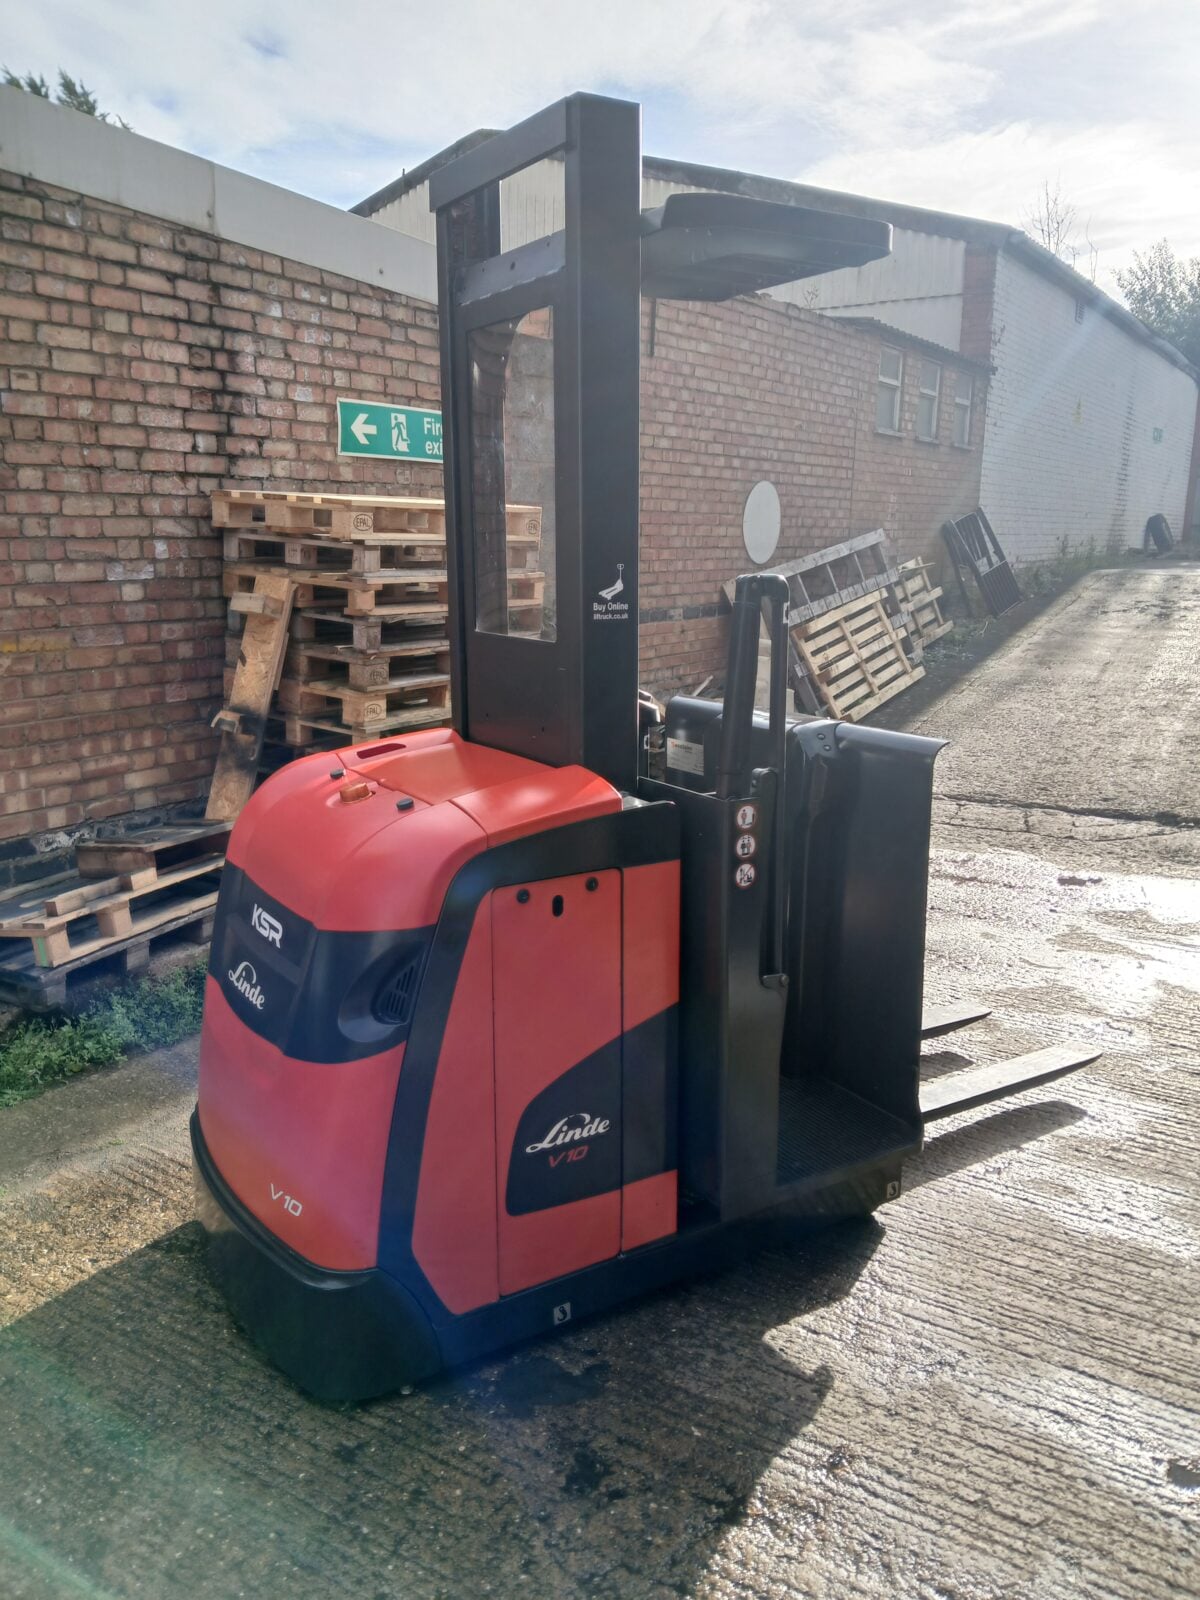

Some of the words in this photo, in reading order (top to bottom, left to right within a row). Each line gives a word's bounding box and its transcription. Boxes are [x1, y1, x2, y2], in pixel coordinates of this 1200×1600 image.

[423, 417, 442, 436] Fir
[425, 439, 443, 456] exi
[355, 515, 372, 528] EPAL
[593, 602, 606, 612] Buy
[607, 602, 629, 610] Online
[251, 903, 283, 949] KSR
[228, 961, 265, 1010] Linde
[525, 1112, 610, 1153] Linde
[548, 1145, 588, 1168] V10
[270, 1183, 302, 1216] V10
